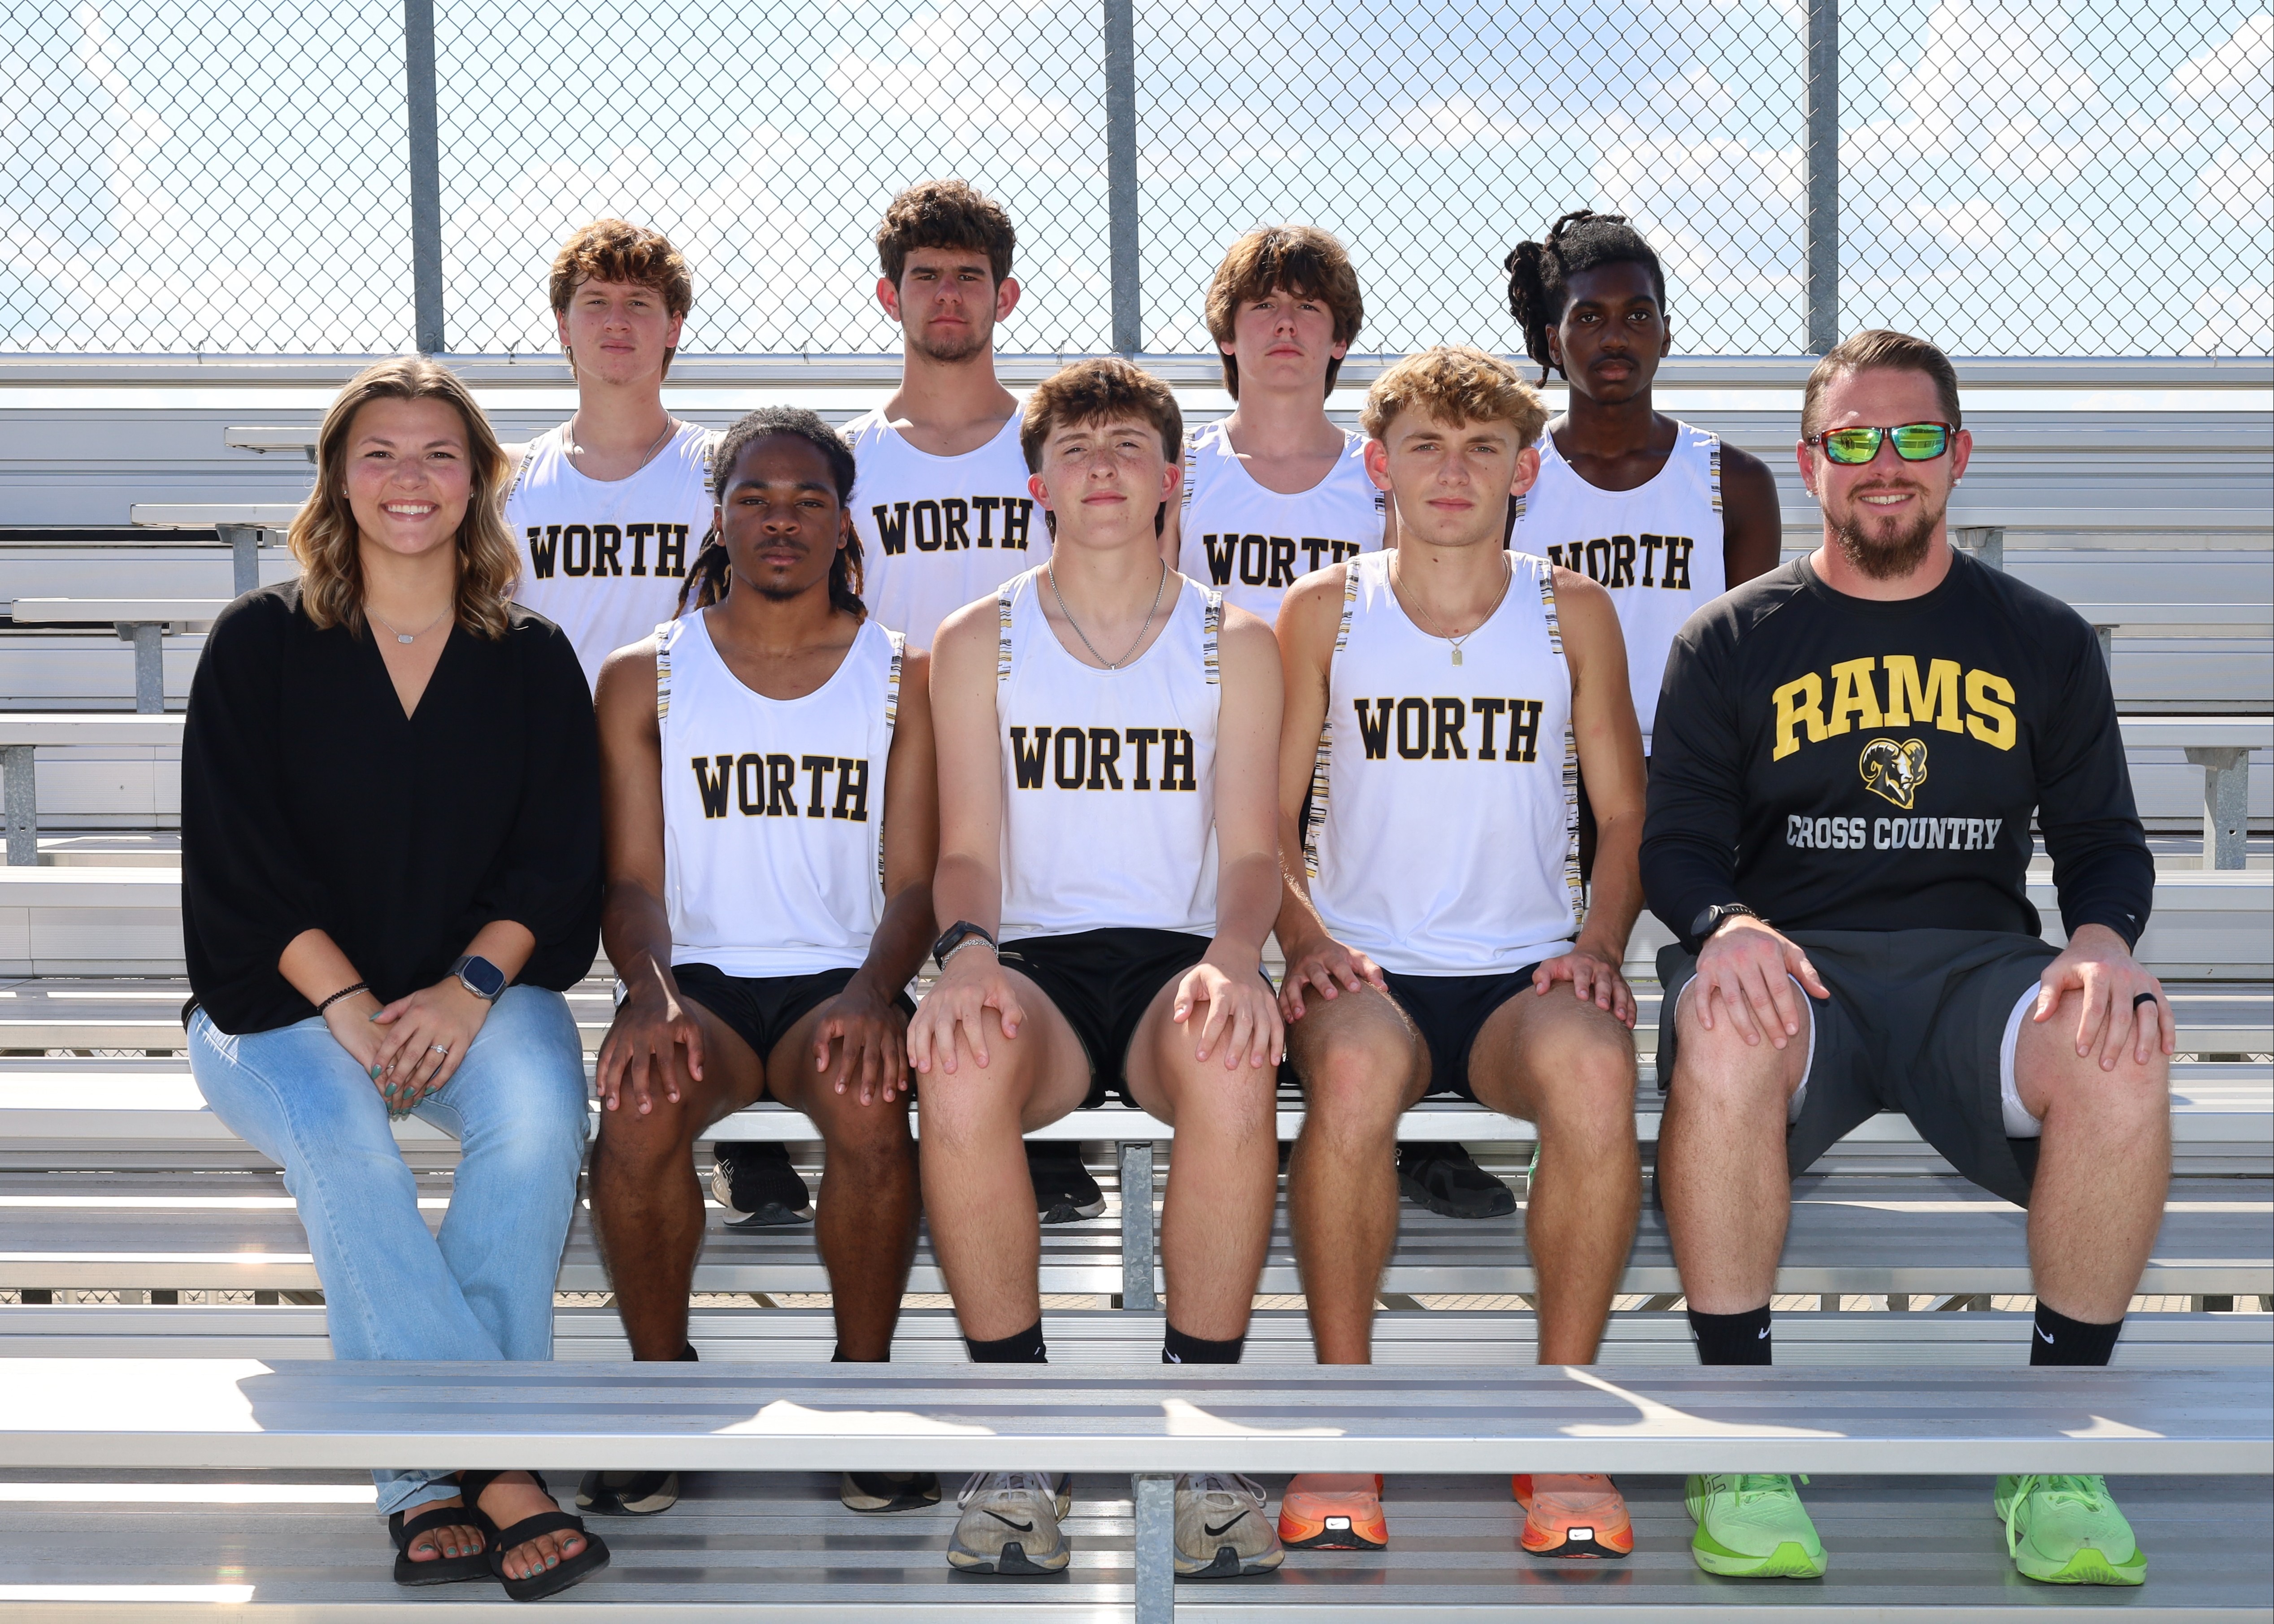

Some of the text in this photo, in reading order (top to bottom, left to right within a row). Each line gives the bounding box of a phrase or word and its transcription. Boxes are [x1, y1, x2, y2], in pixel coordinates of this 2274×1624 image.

[527, 523, 689, 579] WORTH
[872, 496, 1033, 556] WORTH
[1353, 697, 1544, 763] WORTH
[1772, 655, 2016, 762] RAMS
[691, 752, 869, 822] WORTH
[1010, 725, 1197, 791] WORTH
[1787, 814, 2003, 850] CROSS COUNTRY
